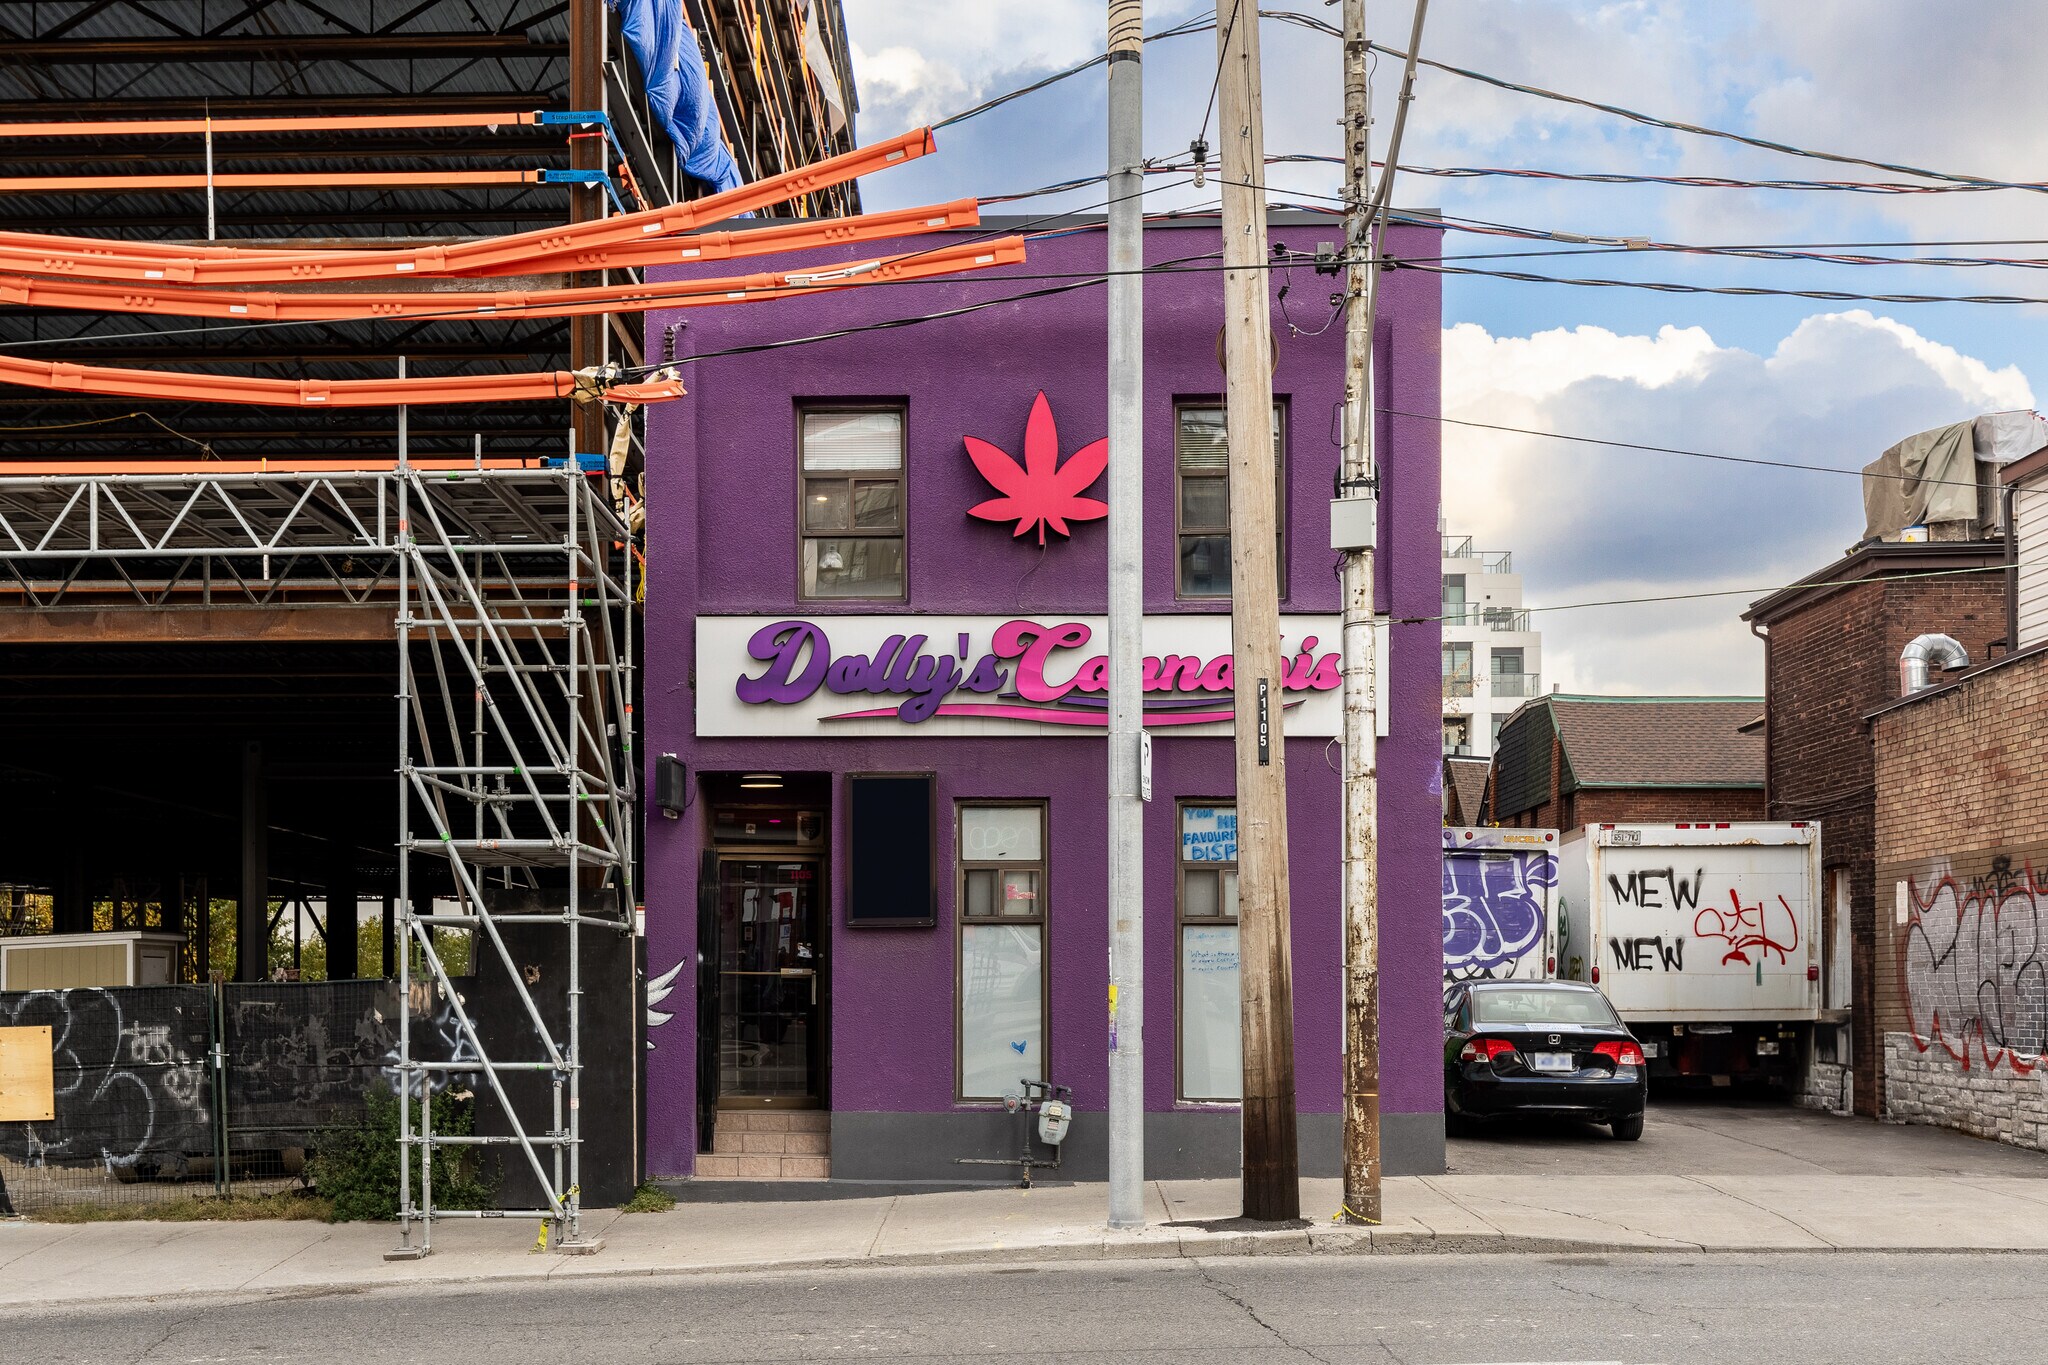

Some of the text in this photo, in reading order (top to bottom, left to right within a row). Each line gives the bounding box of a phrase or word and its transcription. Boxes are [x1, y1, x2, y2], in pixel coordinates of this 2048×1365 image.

[735, 619, 1342, 724] Dolly's Cannais
[1259, 684, 1267, 747] P1105
[1607, 866, 1704, 911] MEW
